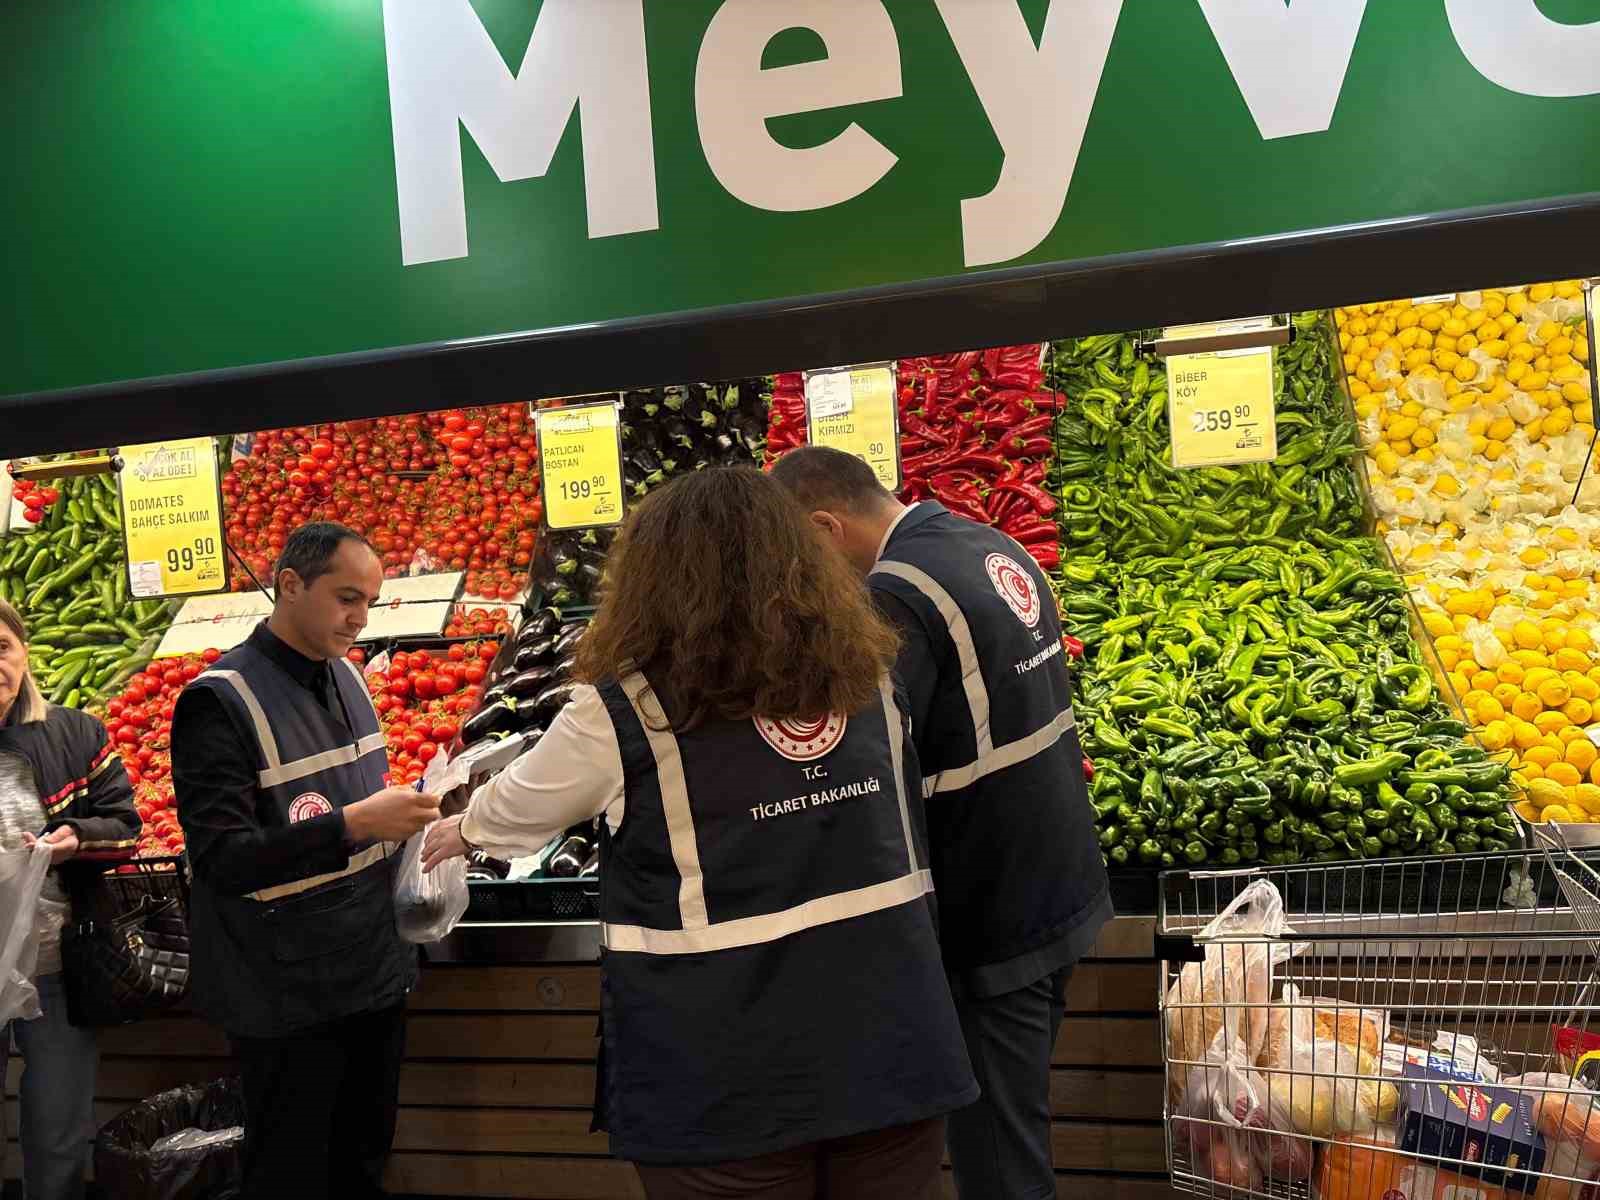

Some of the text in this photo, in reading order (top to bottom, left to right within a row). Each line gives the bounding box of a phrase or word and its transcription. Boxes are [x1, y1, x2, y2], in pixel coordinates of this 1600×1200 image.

[1175, 371, 1208, 384] BİBER
[1176, 385, 1198, 398] KÖY
[1192, 404, 1251, 432] 259 90
[818, 423, 855, 437] KIRMIZI
[544, 444, 585, 457] PATLICAN
[869, 442, 884, 455] 90
[545, 457, 579, 470] BOSTAN
[559, 475, 605, 500] 199 90
[129, 494, 184, 512] DOMATES
[131, 509, 210, 531] BAHÇE SALKIM
[167, 537, 214, 572] 99 90
[800, 765, 828, 781] T.C.
[749, 776, 881, 821] TİCARET BAKANLIĞI
